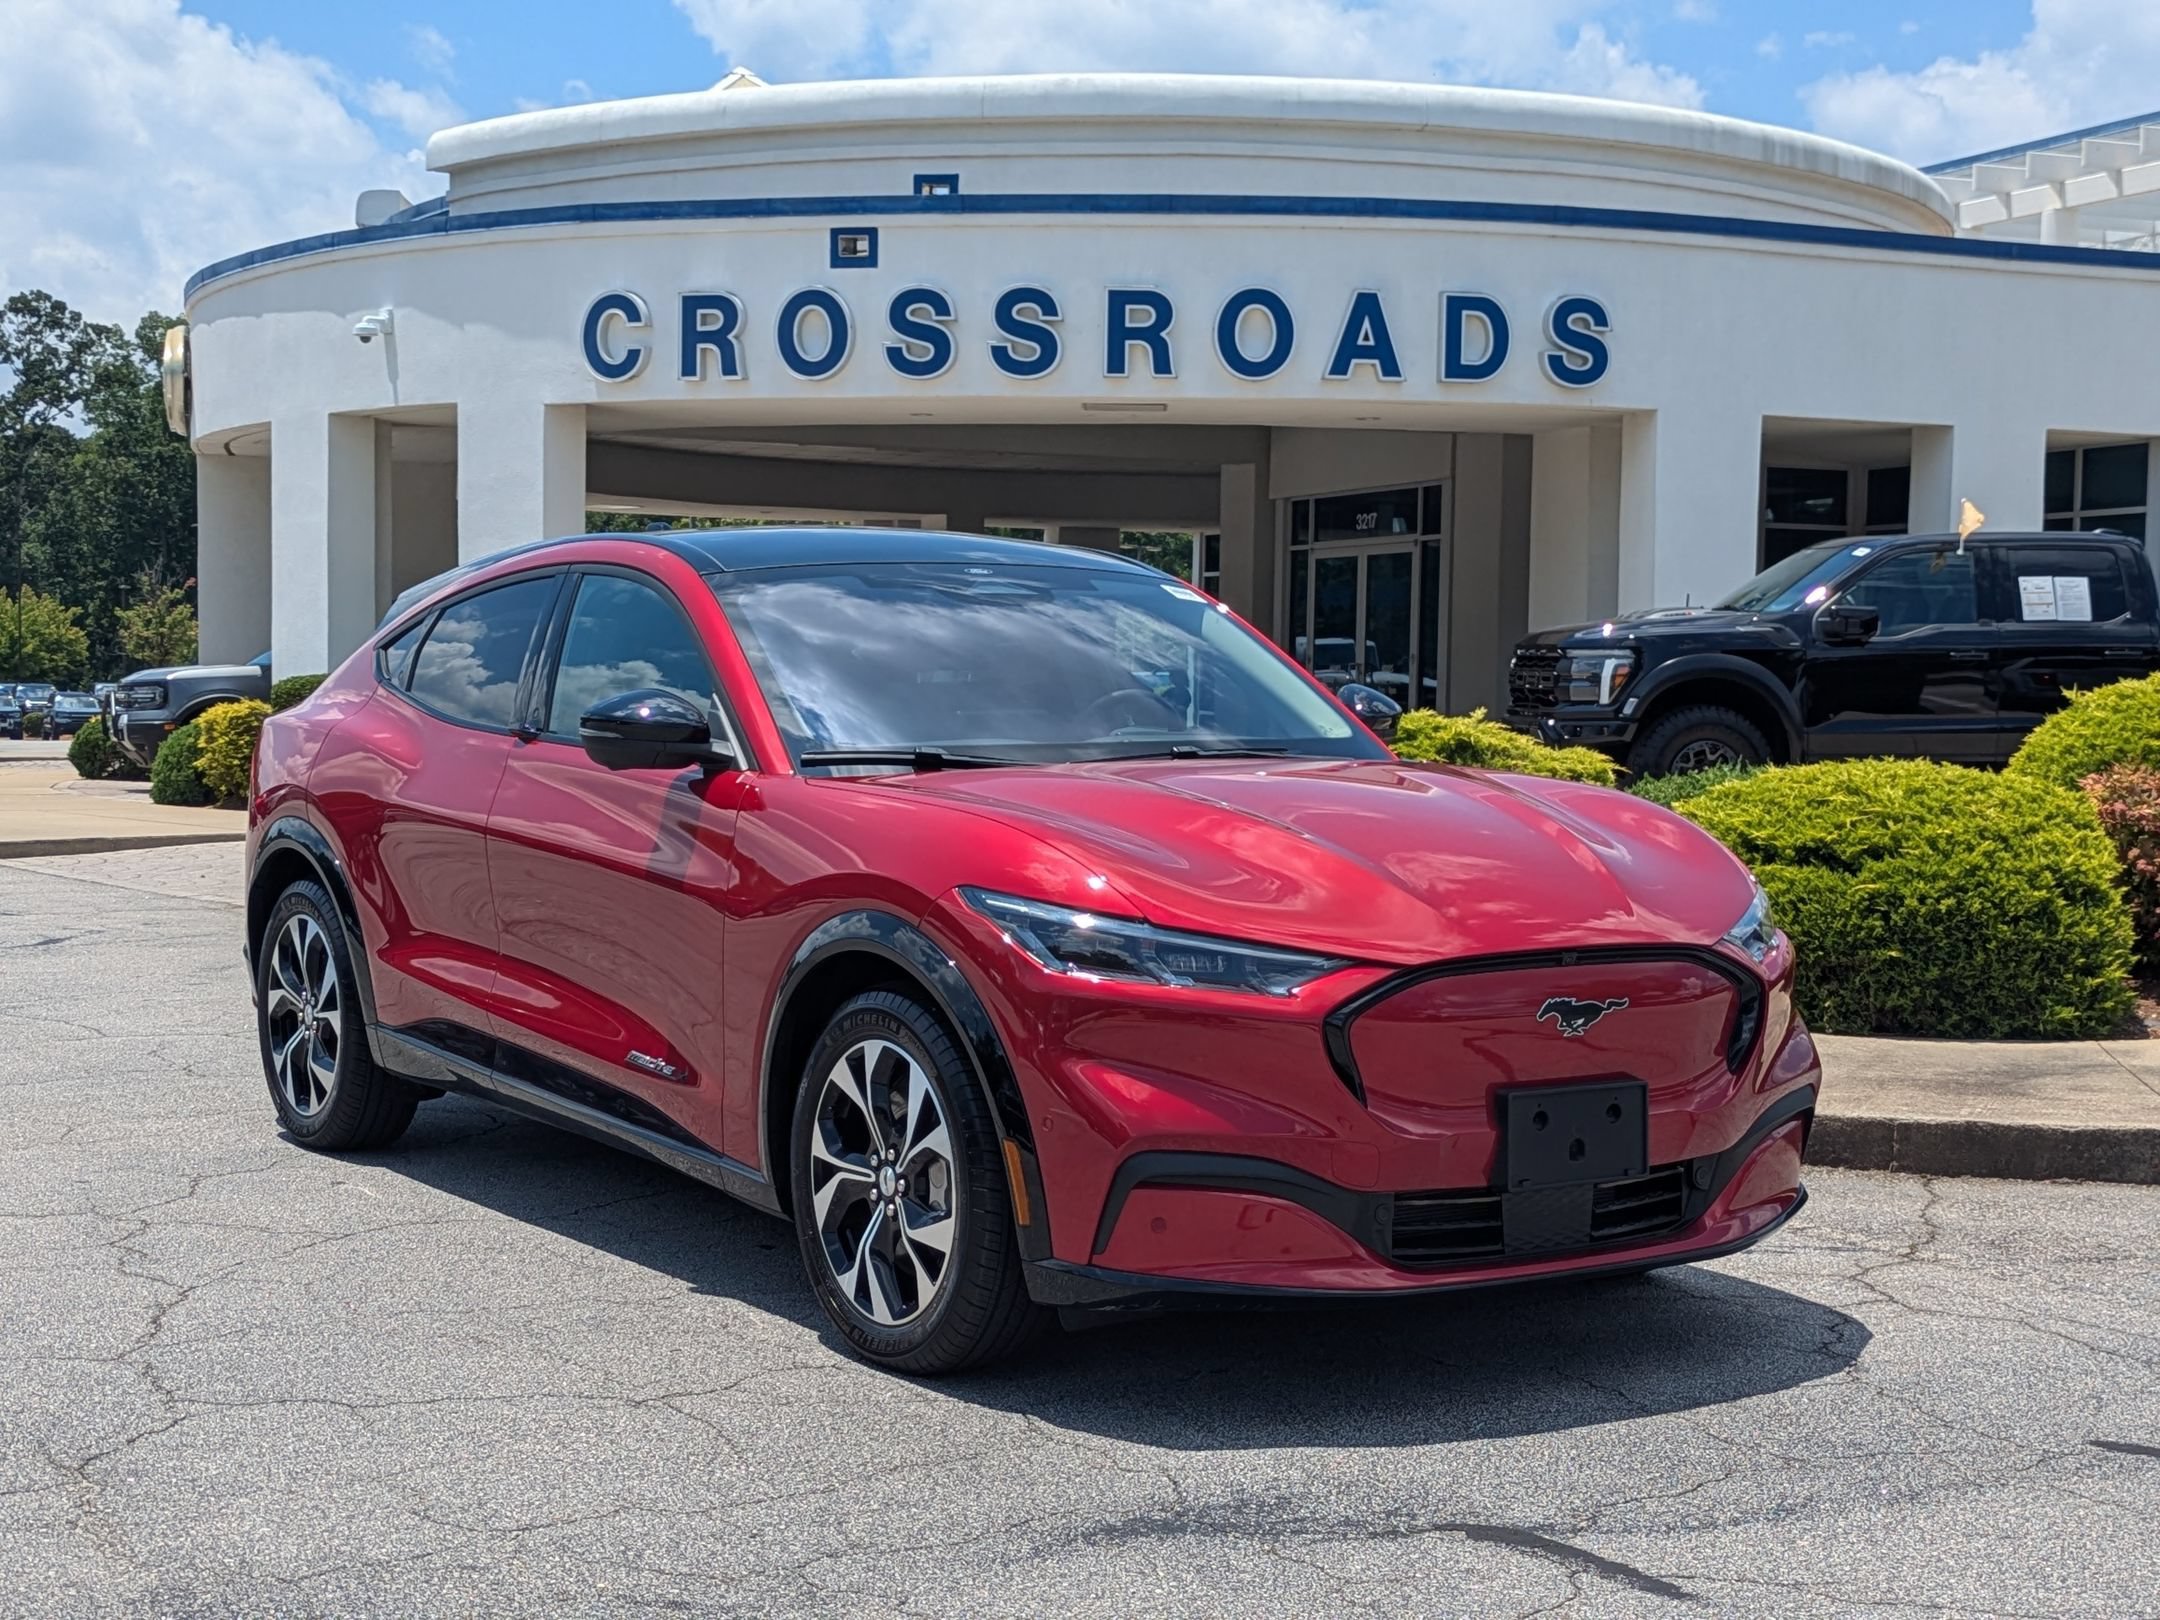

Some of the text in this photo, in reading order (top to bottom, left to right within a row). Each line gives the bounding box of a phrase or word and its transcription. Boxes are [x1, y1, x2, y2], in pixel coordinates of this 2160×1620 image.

[579, 283, 1612, 388] CROSSROADS
[1355, 512, 1378, 530] 3217
[842, 1014, 898, 1033] MICHELIN
